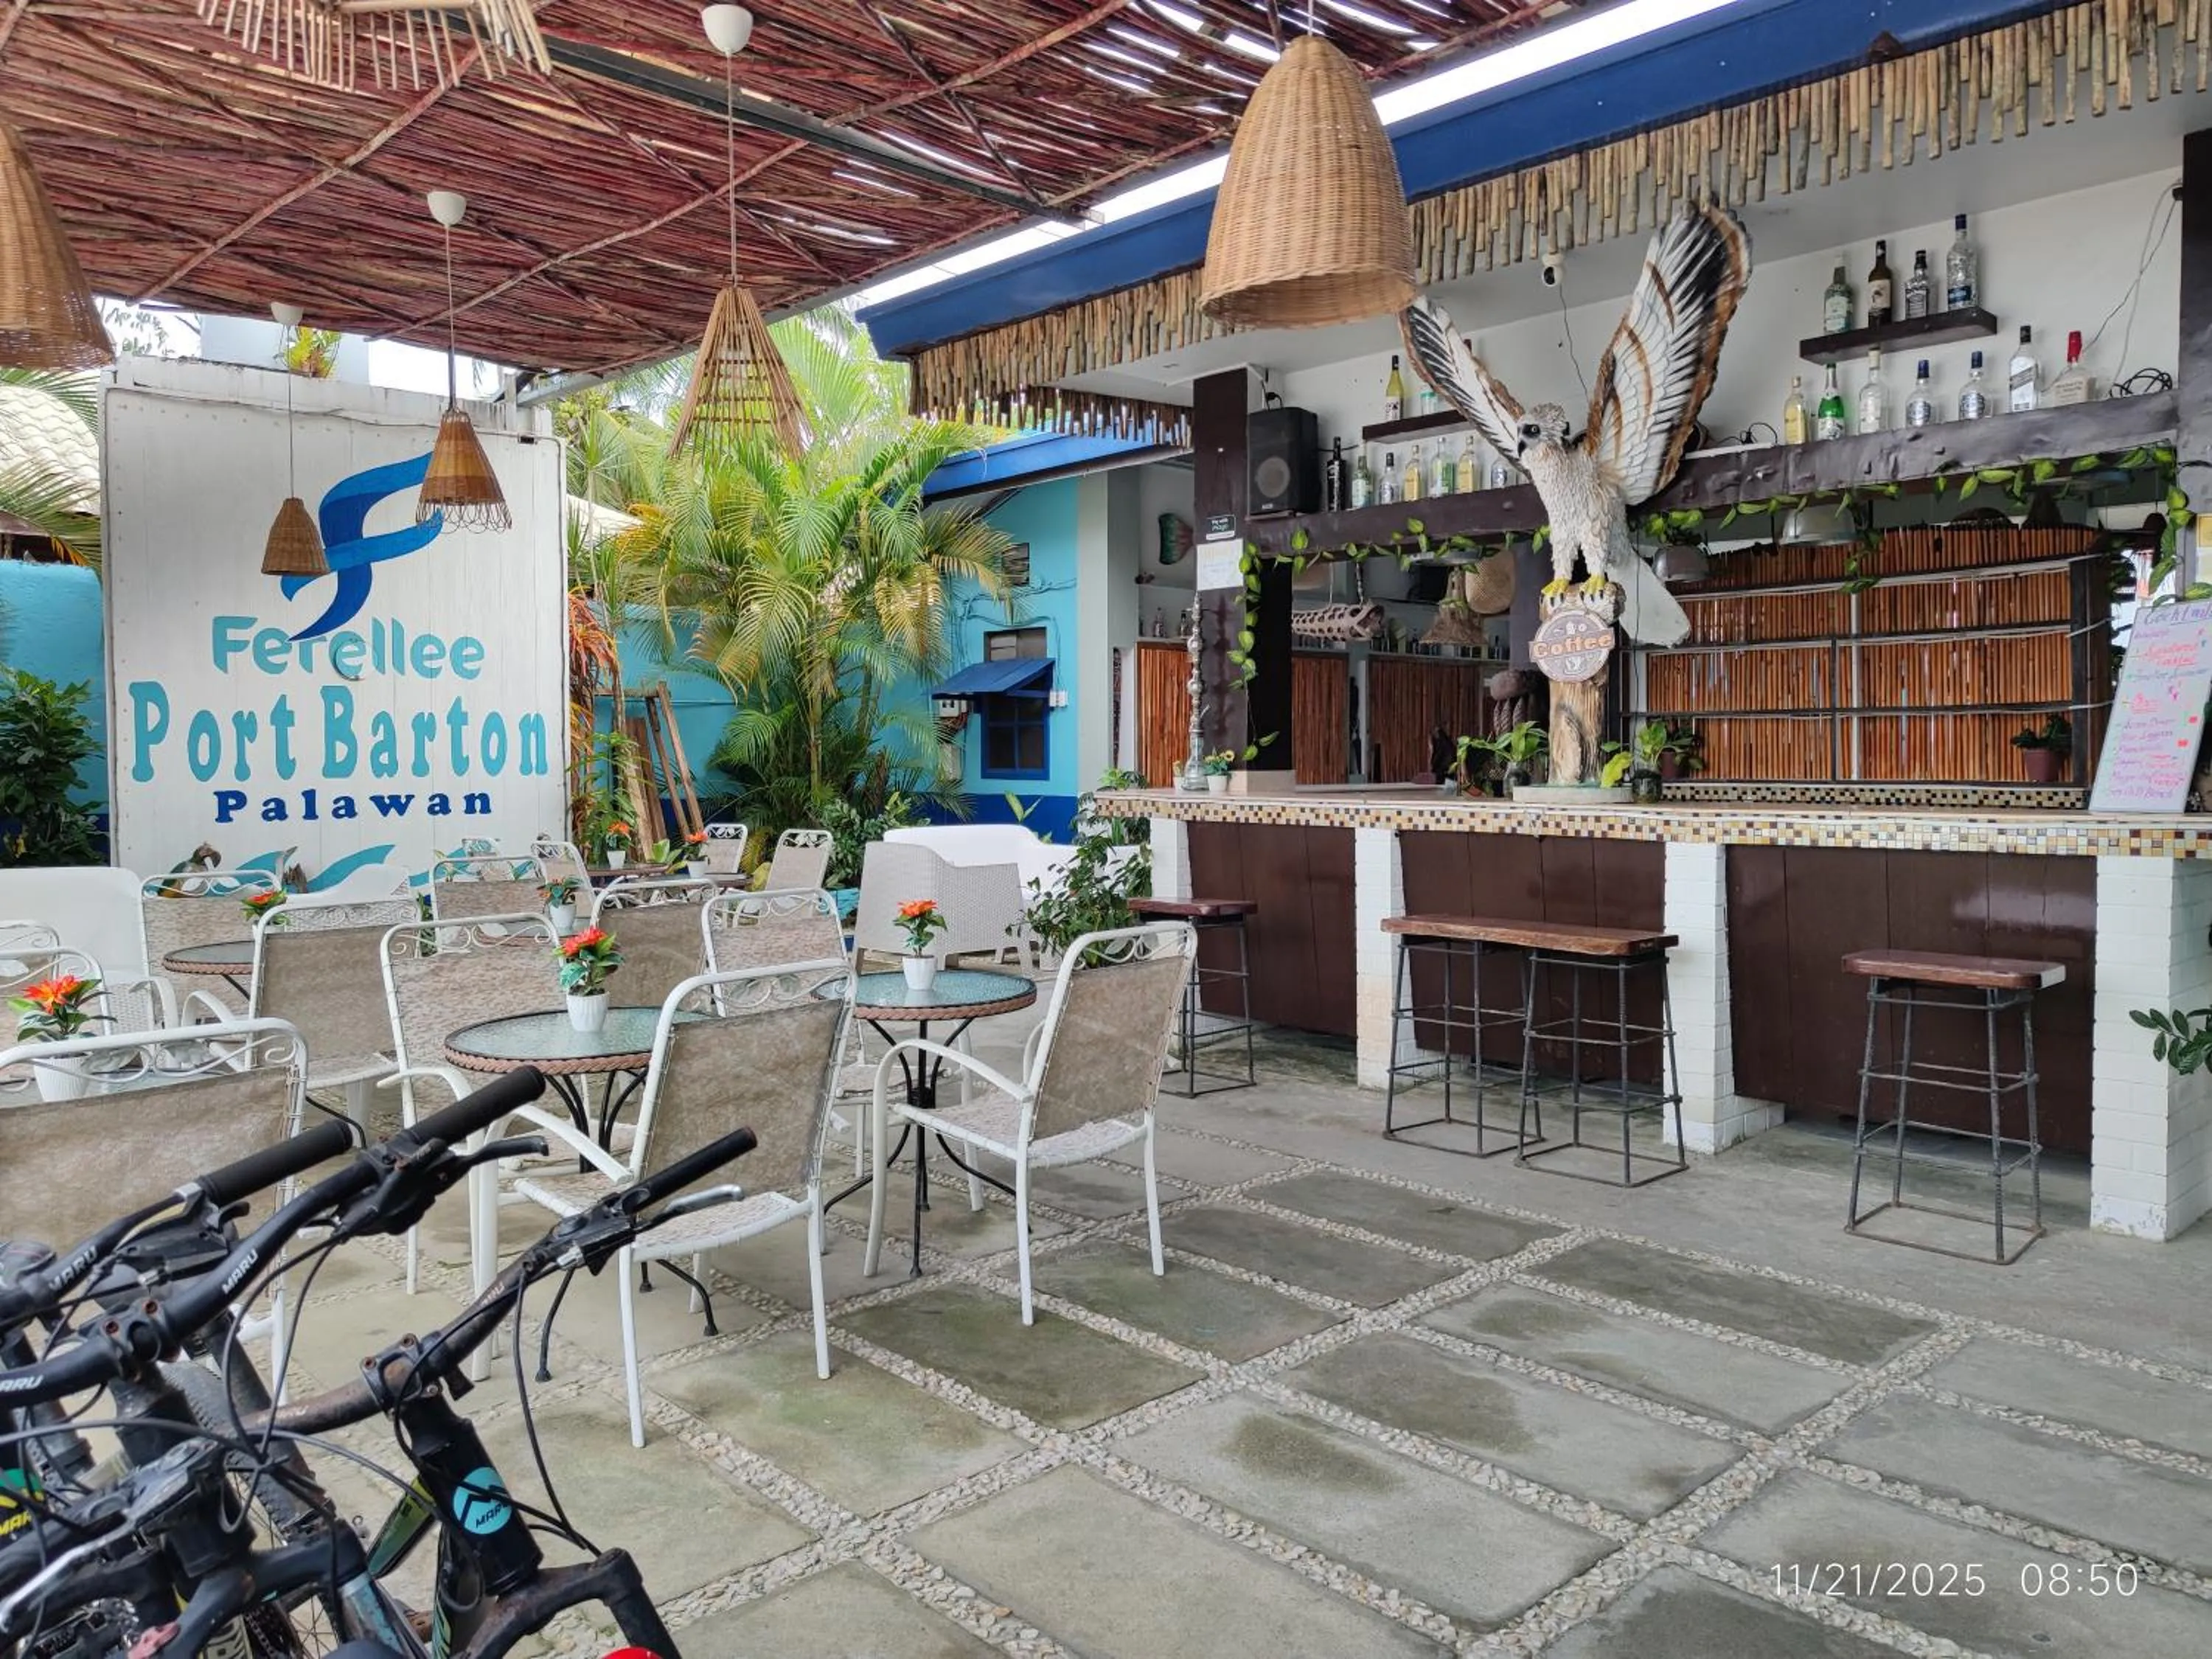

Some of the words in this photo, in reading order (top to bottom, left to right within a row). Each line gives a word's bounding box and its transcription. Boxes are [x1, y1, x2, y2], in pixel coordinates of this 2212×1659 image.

[212, 616, 485, 679] Ferellee
[128, 681, 296, 782] Port
[319, 685, 549, 779] Barton
[214, 789, 491, 823] Palawan
[222, 1248, 258, 1294] MARU
[0, 1374, 44, 1392] ARU
[0, 1510, 32, 1536] MAR
